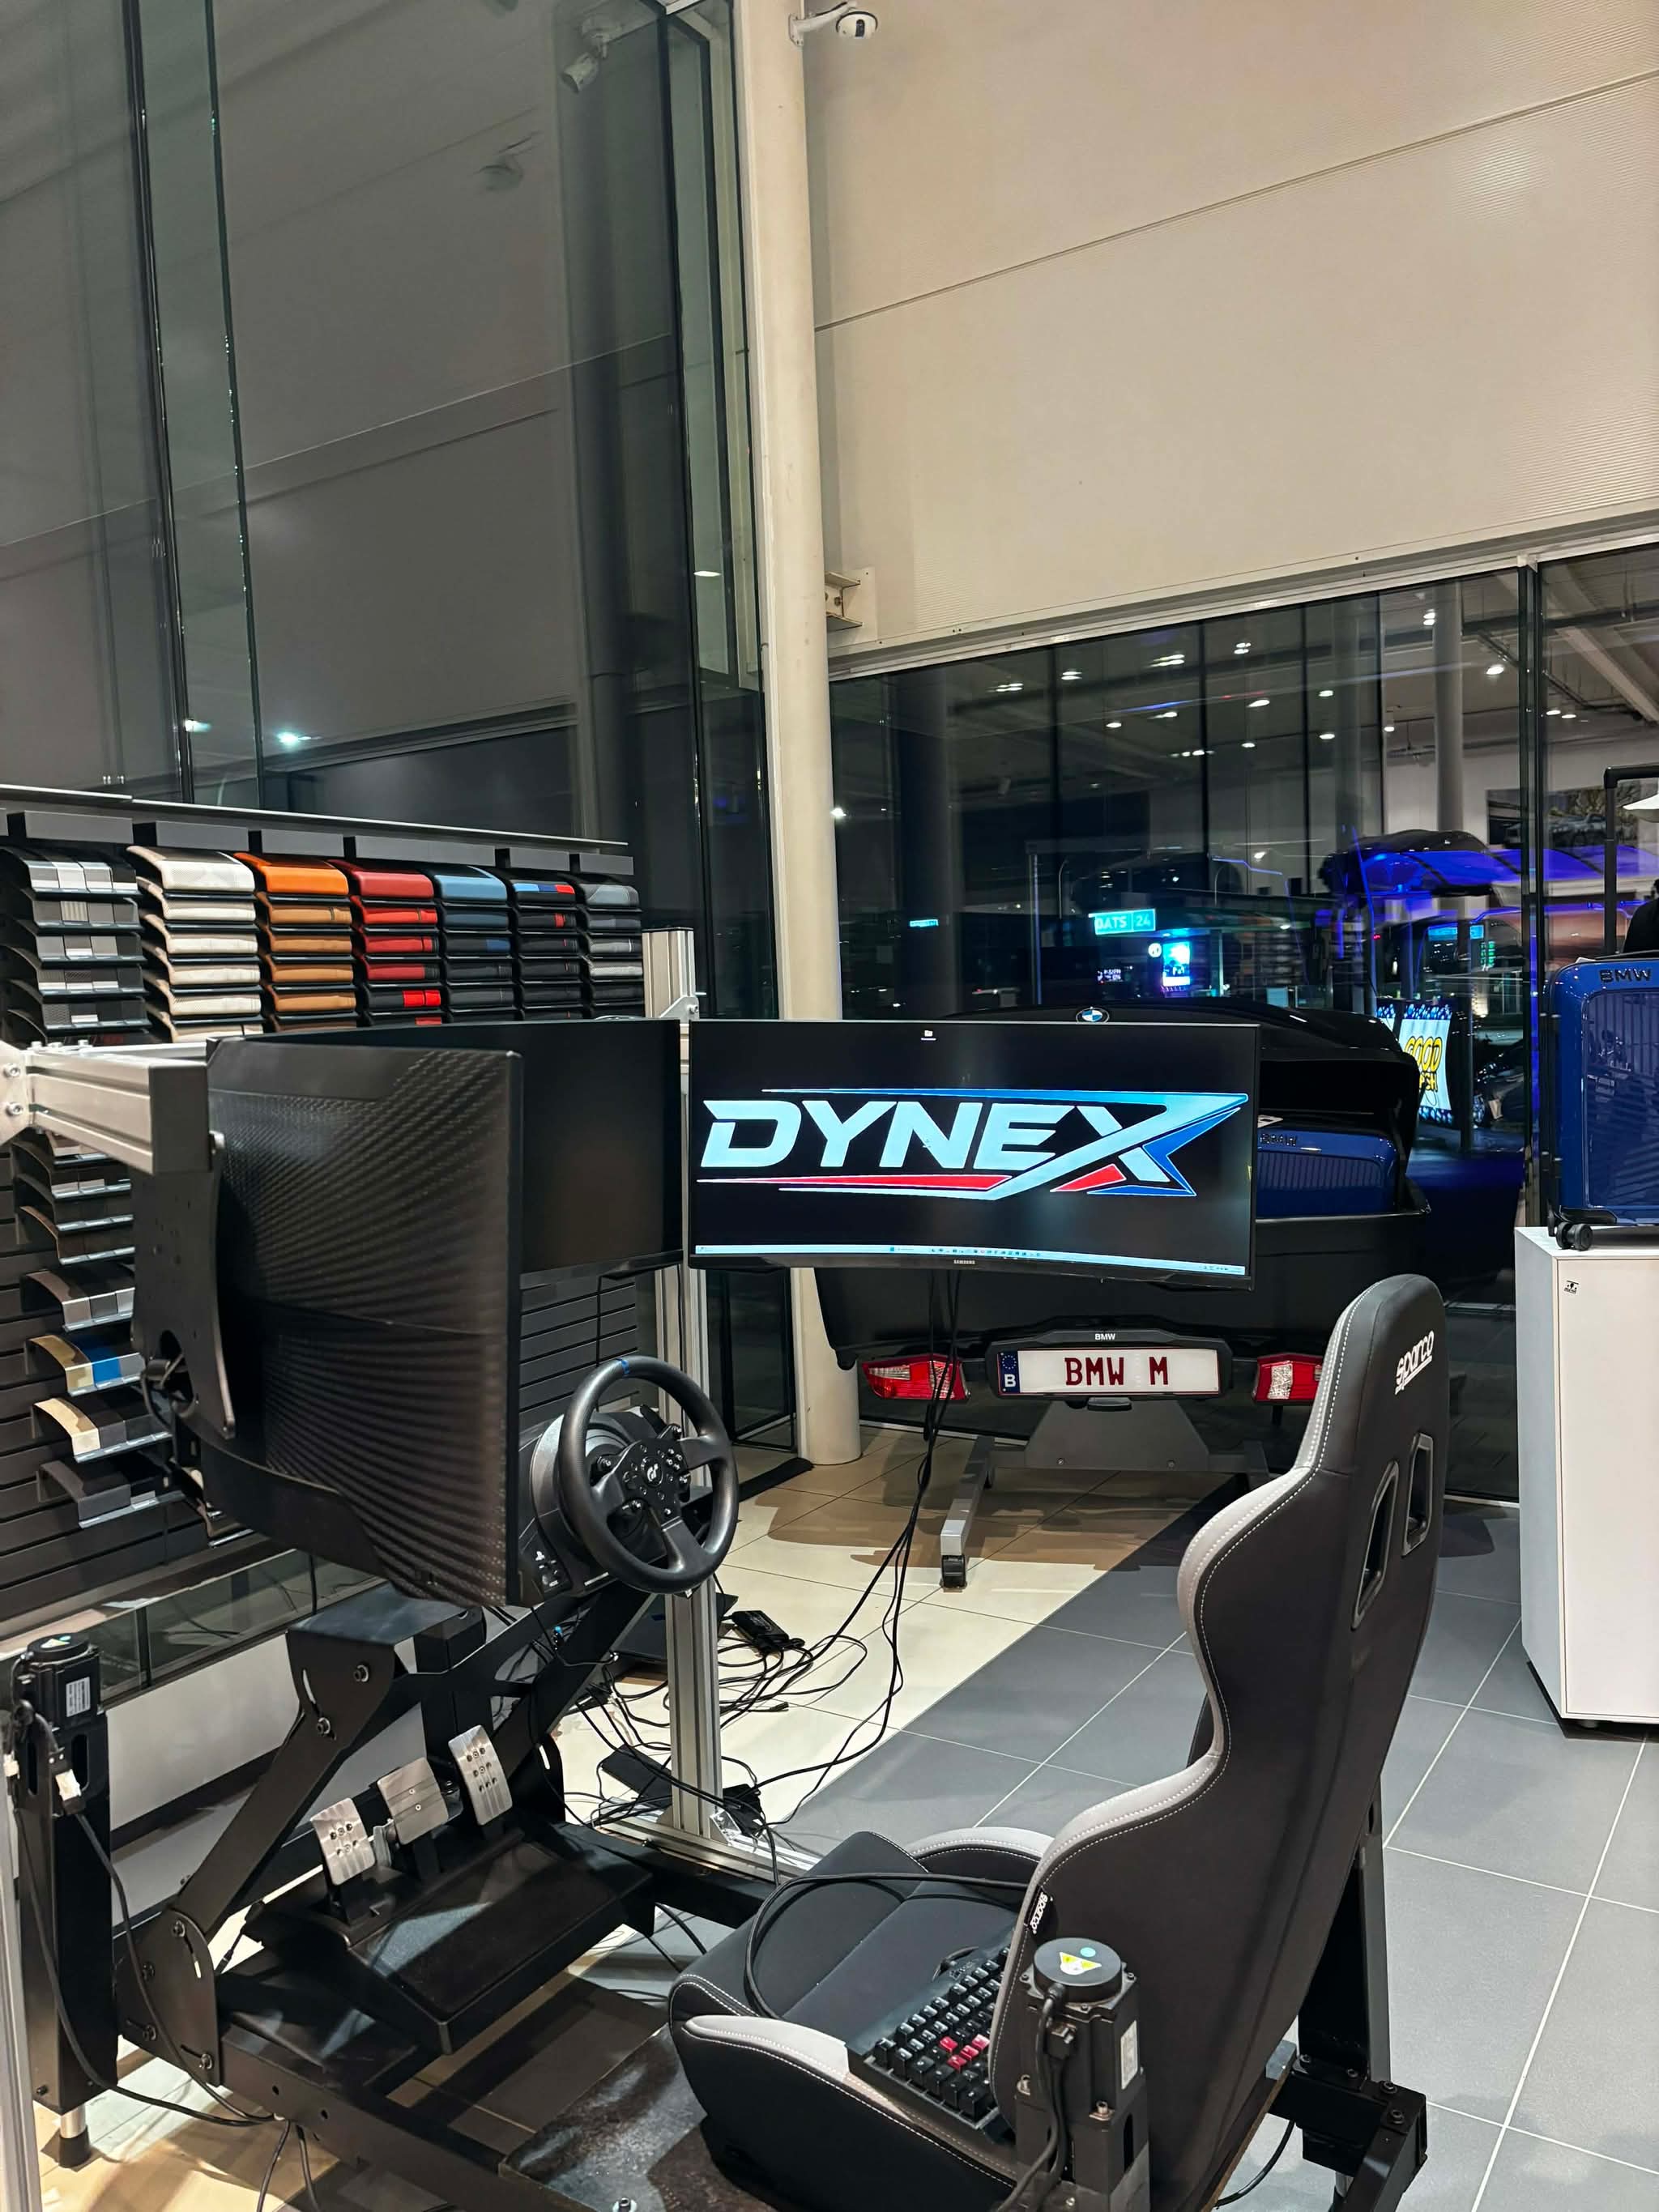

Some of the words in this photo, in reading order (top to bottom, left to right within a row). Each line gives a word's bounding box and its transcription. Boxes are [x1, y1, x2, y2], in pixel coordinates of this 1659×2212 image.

[1136, 914, 1151, 927] 24
[1599, 968, 1652, 982] BMW
[700, 1089, 1248, 1200] DYNEX
[1094, 1332, 1116, 1340] BMW
[1395, 1330, 1435, 1392] sparco
[1064, 1357, 1124, 1386] BMW
[1149, 1356, 1169, 1386] M
[1004, 1374, 1017, 1387] B
